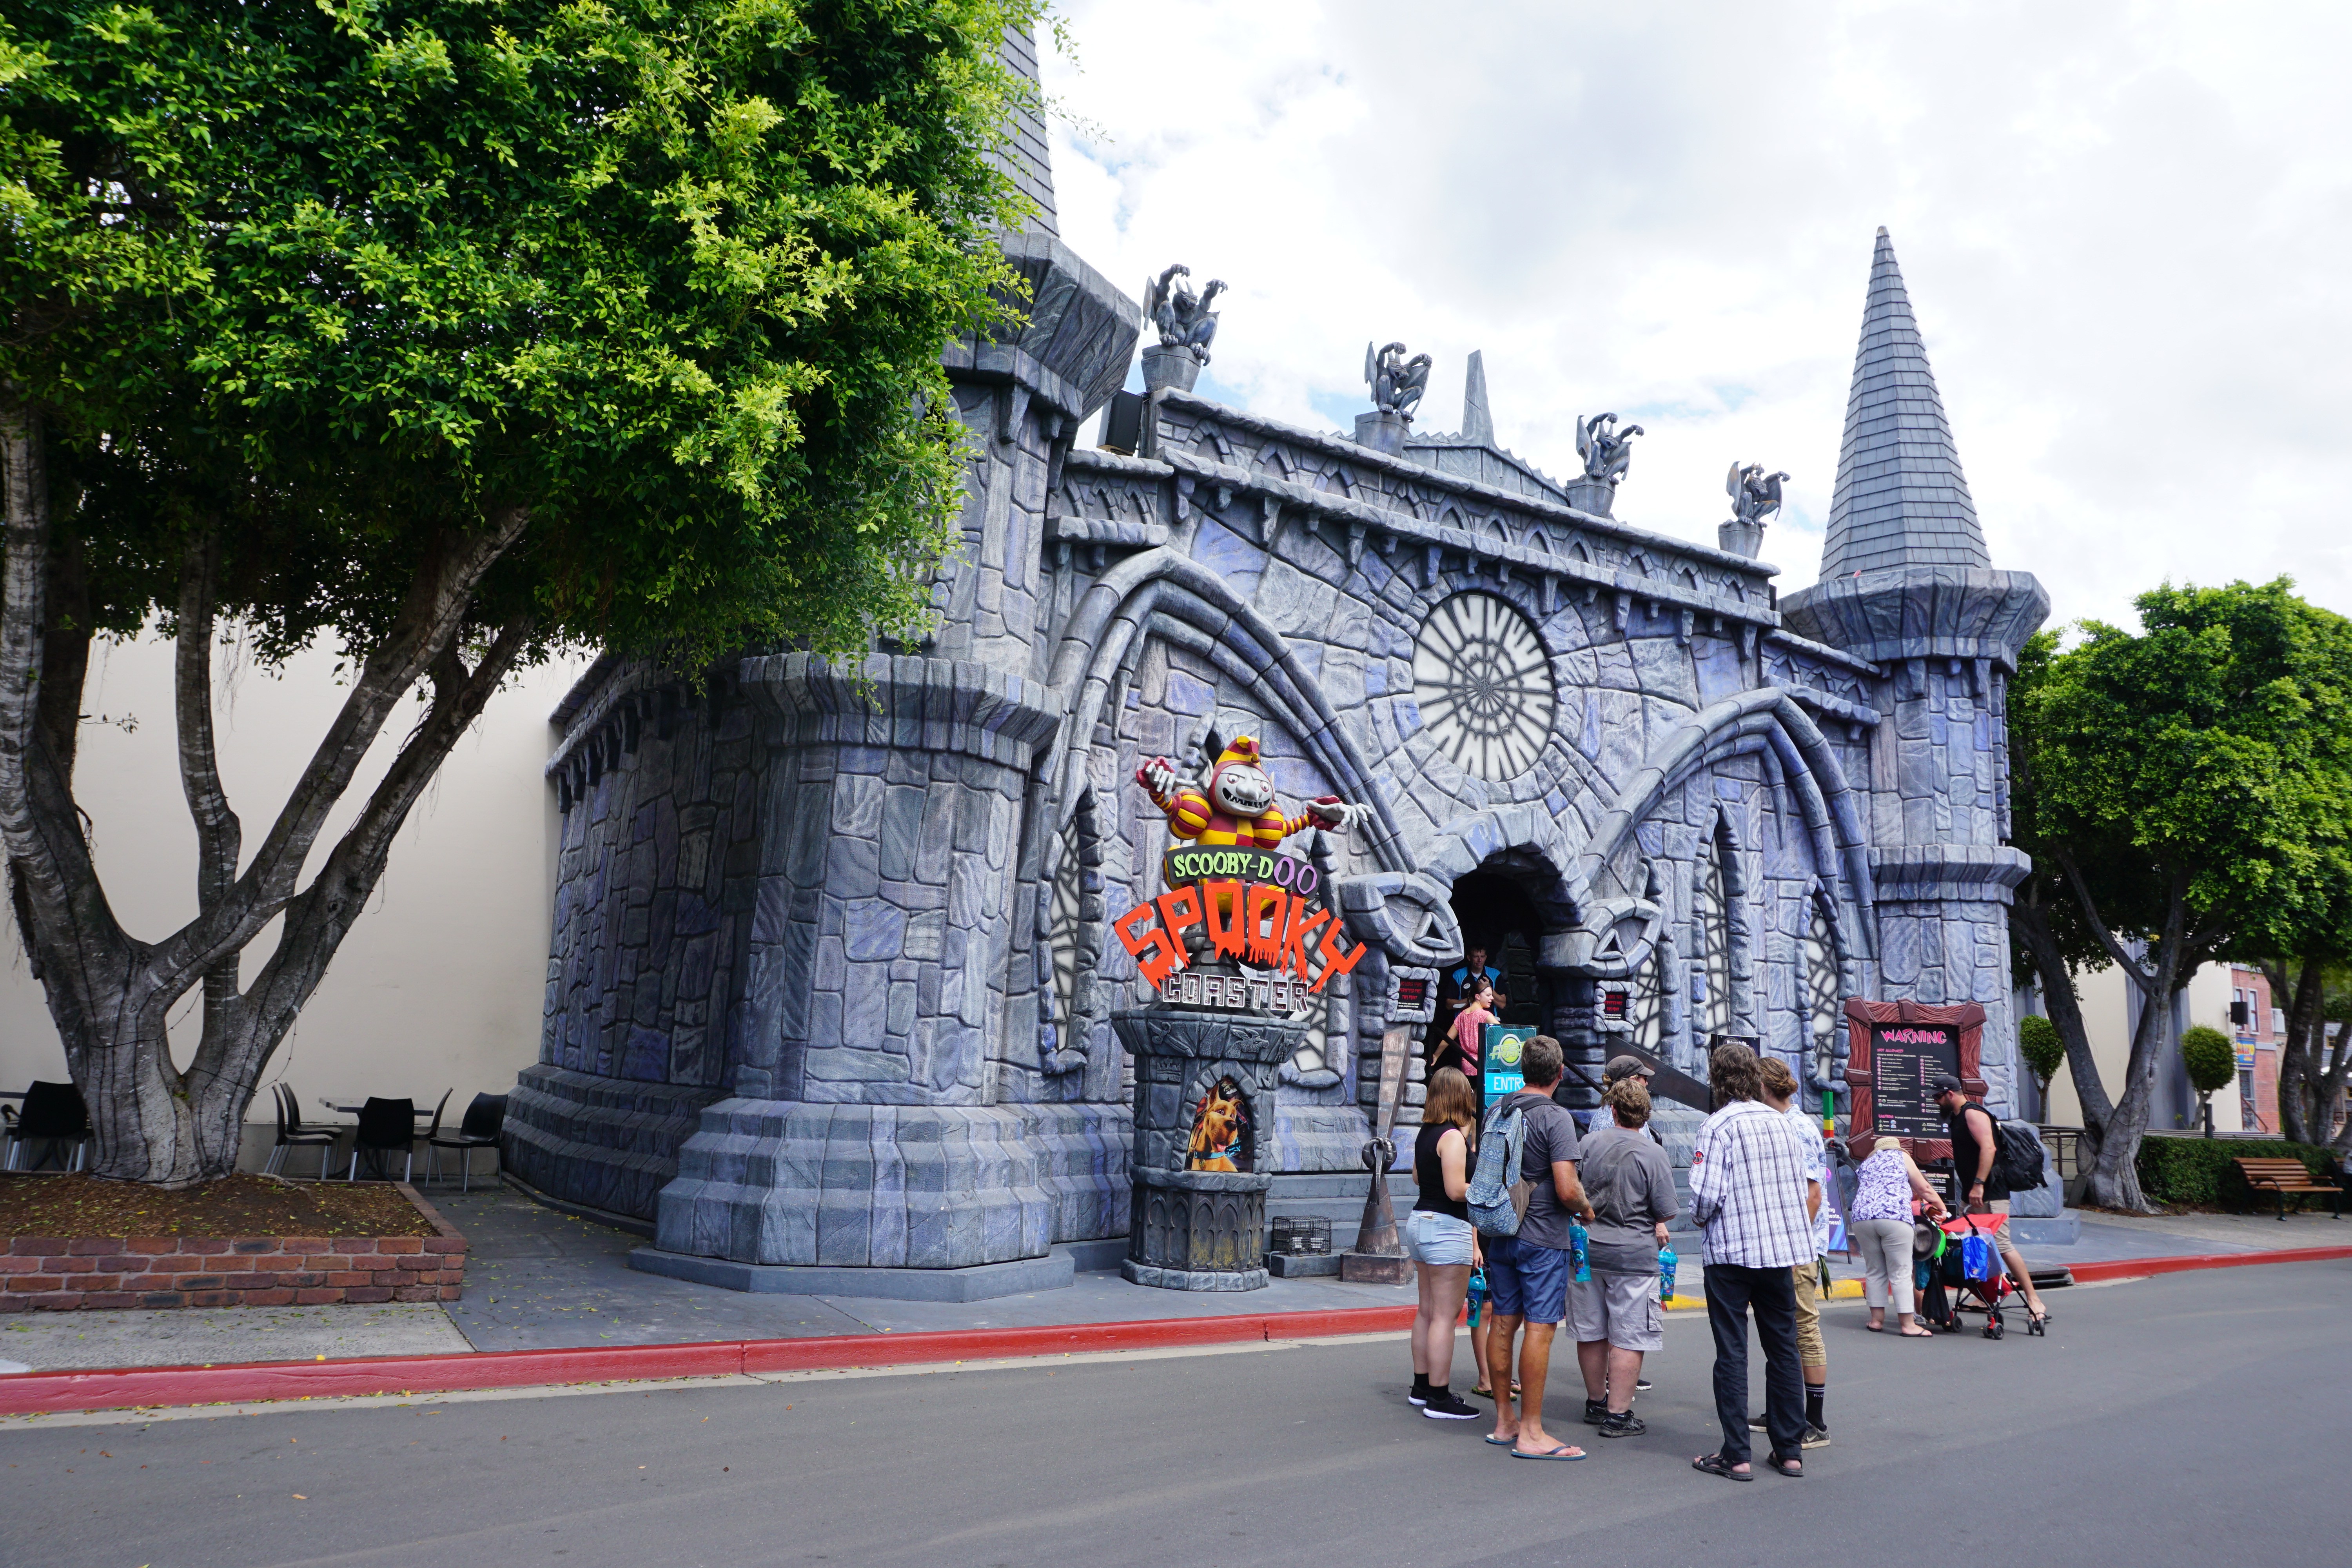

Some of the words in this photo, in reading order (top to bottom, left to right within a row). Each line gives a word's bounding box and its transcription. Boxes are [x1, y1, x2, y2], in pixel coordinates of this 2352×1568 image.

[1174, 851, 1318, 895] SCOOBY-DOO
[1114, 882, 1367, 993] SPOOKY
[1161, 971, 1308, 1012] COASTER
[1489, 1049, 1522, 1060] TRAC
[1880, 1028, 1947, 1044] WARNING
